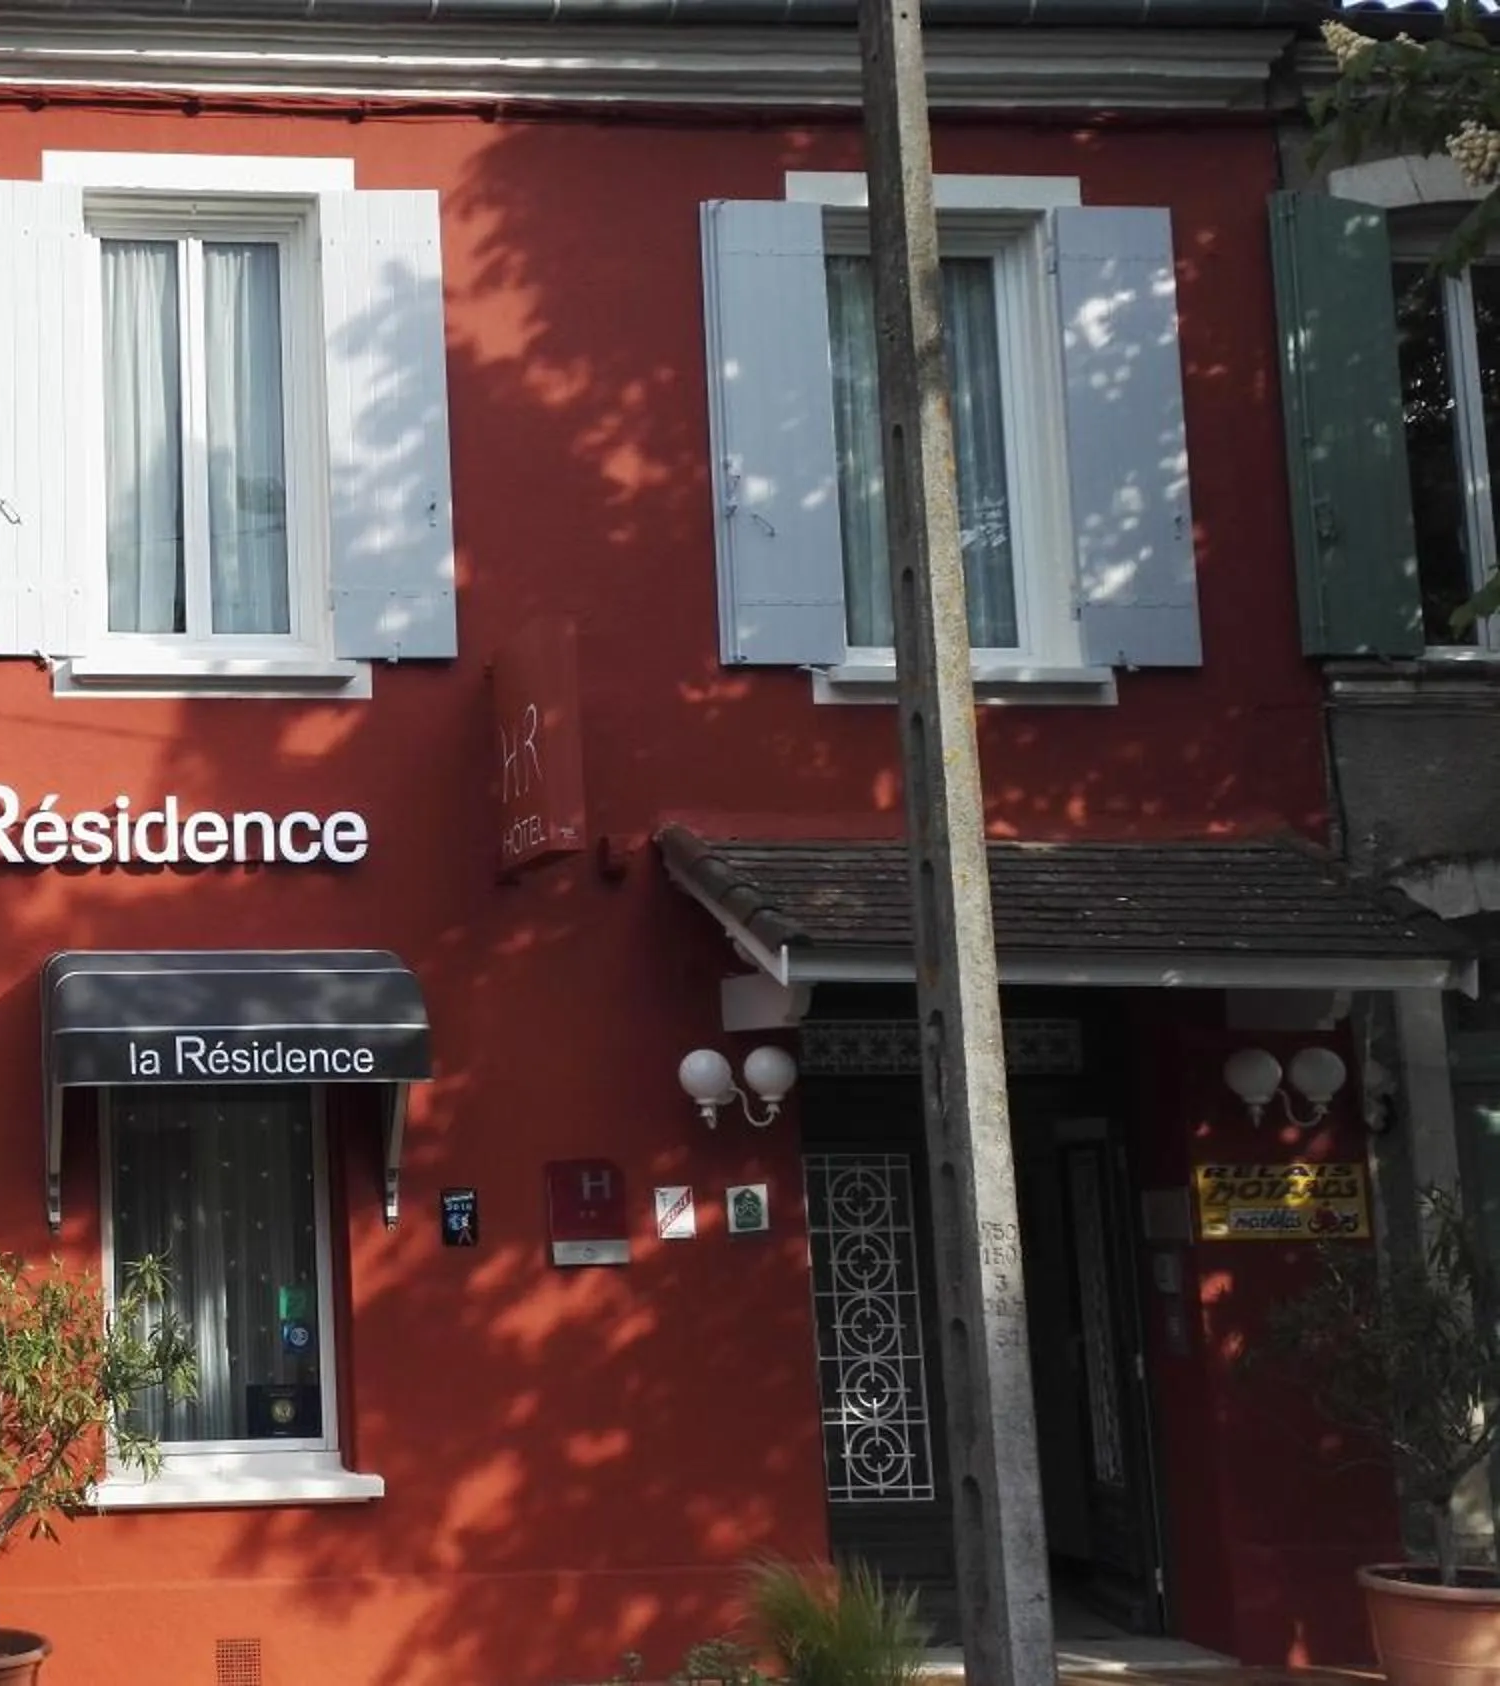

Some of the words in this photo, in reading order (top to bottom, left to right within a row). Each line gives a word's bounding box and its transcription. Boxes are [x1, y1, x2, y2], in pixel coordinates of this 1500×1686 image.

[129, 1042, 161, 1075] la
[175, 1036, 374, 1074] Résidence
[580, 1169, 612, 1202] H
